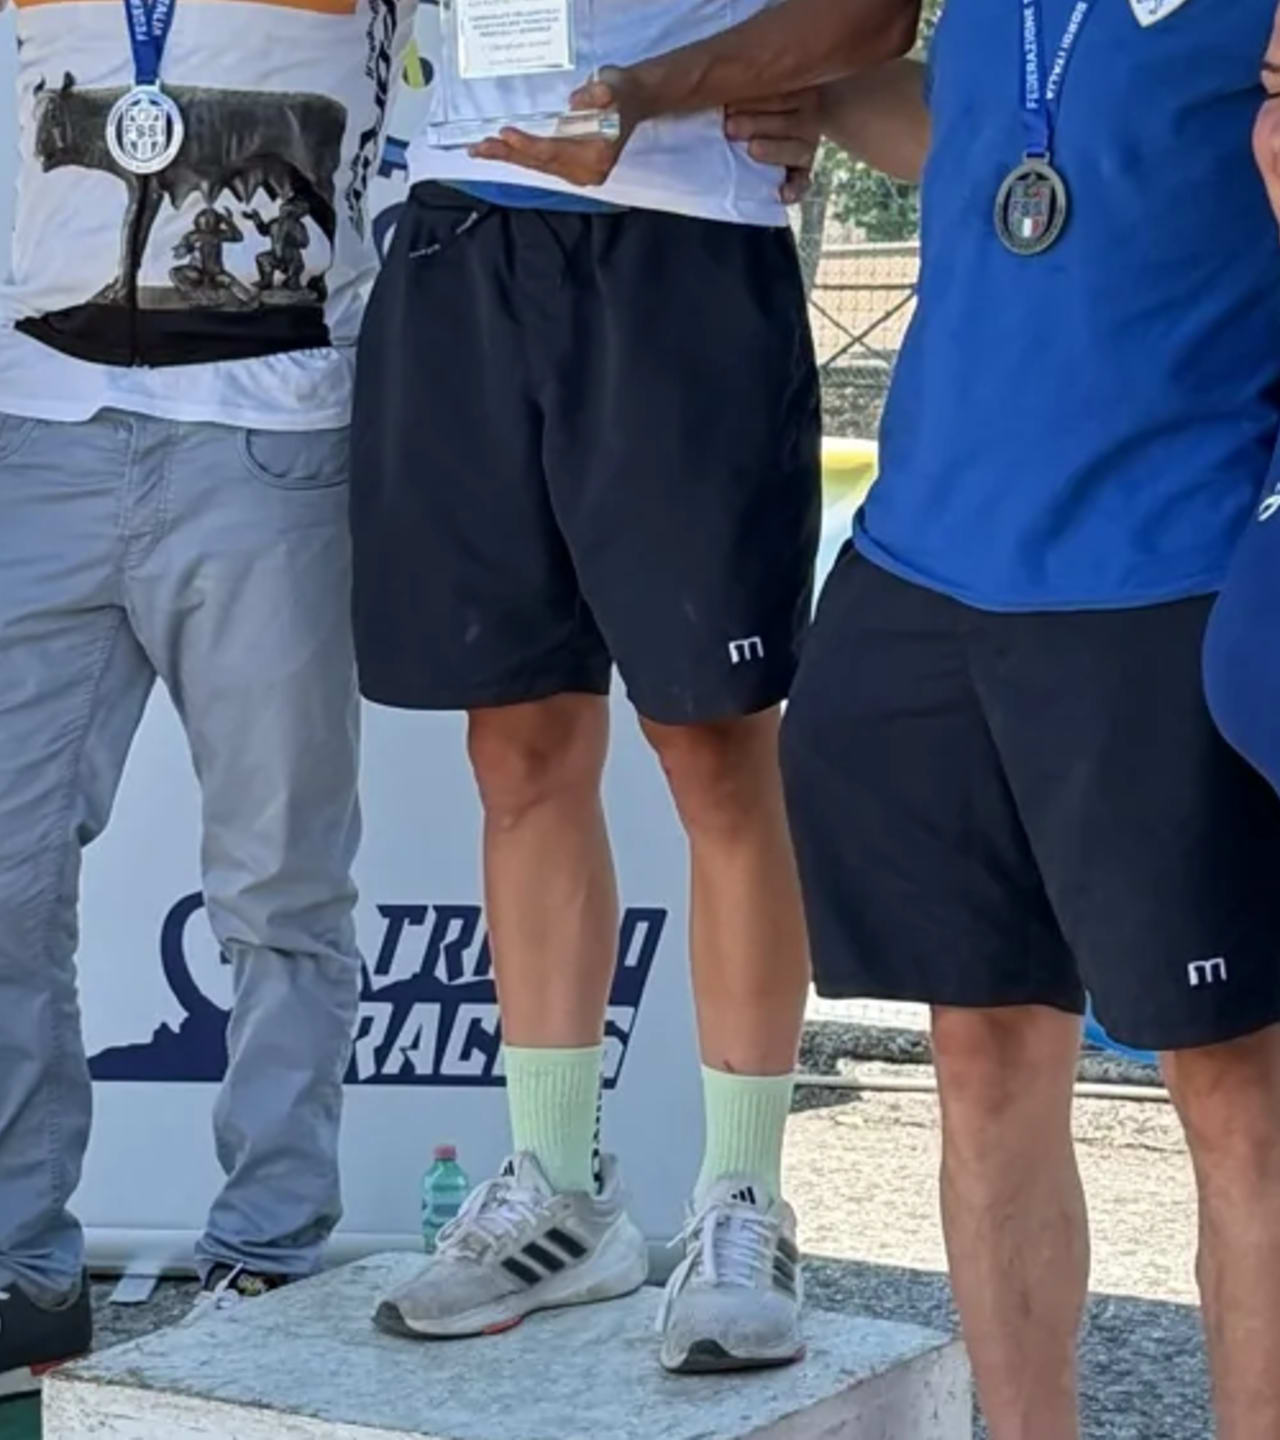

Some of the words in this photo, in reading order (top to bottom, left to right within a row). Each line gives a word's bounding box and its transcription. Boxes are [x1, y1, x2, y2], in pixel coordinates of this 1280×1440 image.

[1061, 1, 1088, 49] SORDI
[1024, 6, 1040, 109] FEDERAZIONE
[1045, 50, 1067, 101] ITALIA
